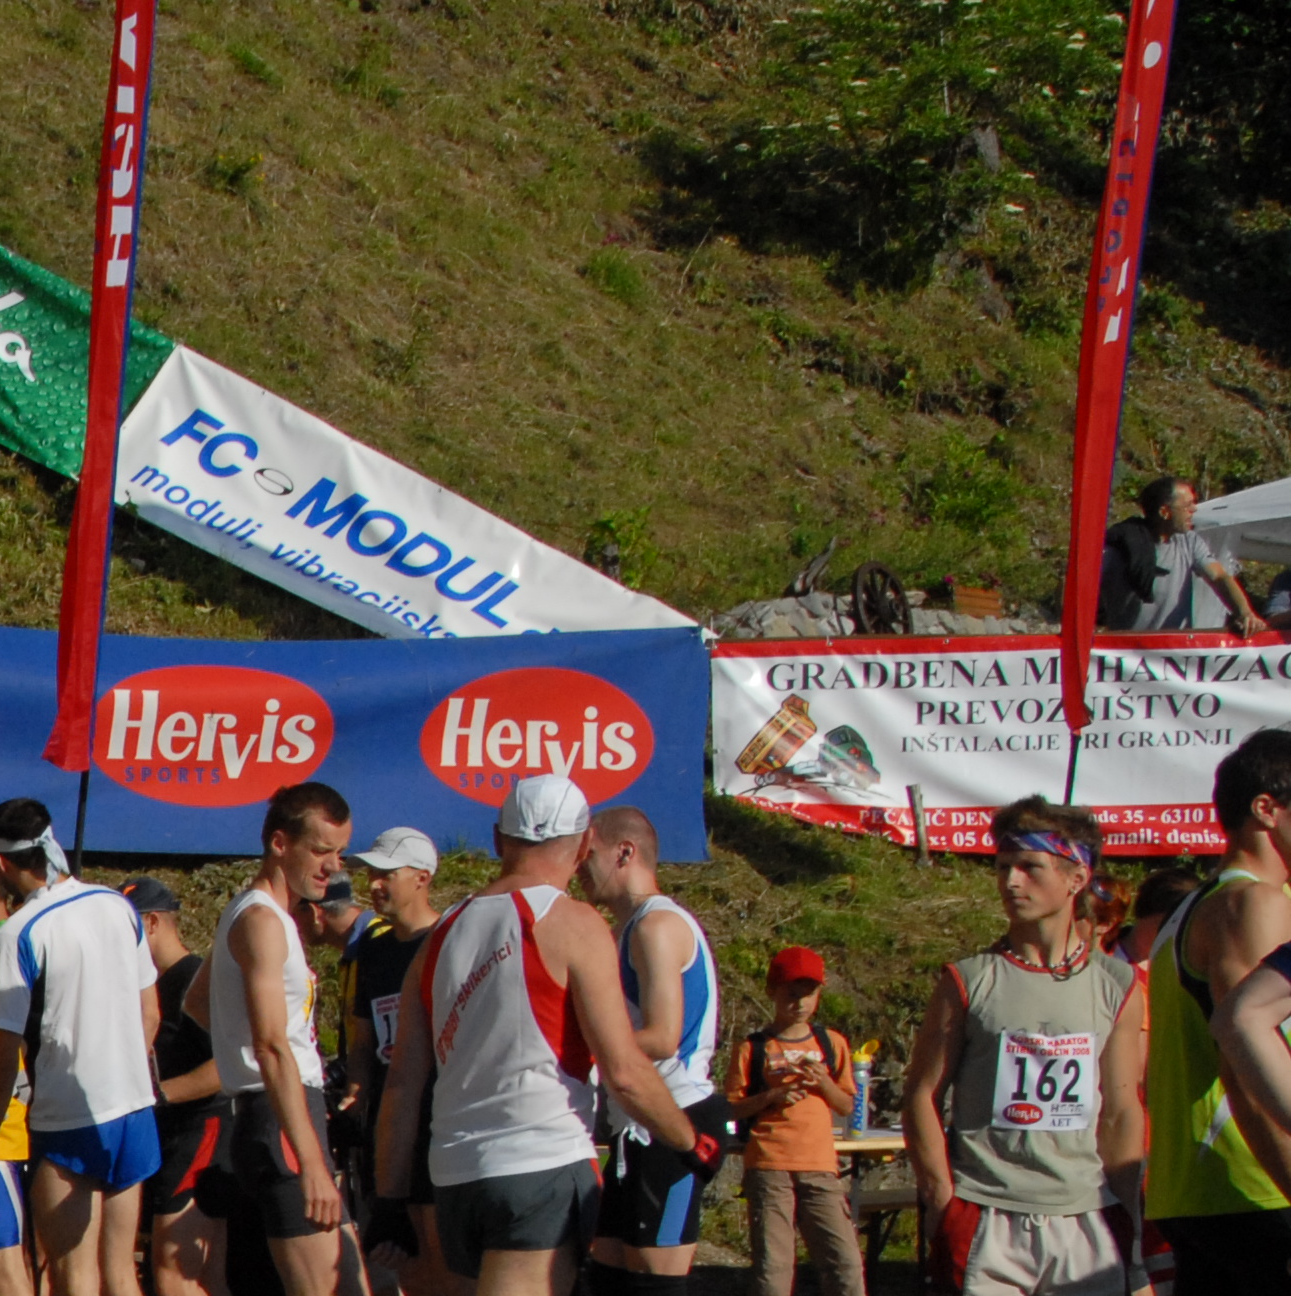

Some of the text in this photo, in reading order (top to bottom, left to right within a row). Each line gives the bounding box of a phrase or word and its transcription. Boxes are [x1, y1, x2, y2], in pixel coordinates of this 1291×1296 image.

[130, 463, 258, 549] moduli,
[160, 408, 523, 629] FC MODUL
[766, 650, 1291, 692] GRADBENA MHANIZA
[107, 689, 315, 778] Hervis
[441, 698, 636, 775] Hervis
[900, 729, 1233, 755] INŠTALACIJE RI GRADNJI
[125, 766, 220, 785] SPORTS
[1123, 809, 1144, 824] 35
[1160, 808, 1197, 824] 6310
[953, 831, 976, 847] 05
[1102, 828, 1160, 845] -mail:
[1011, 1056, 1081, 1103] 162
[1050, 1117, 1072, 1127] AET
